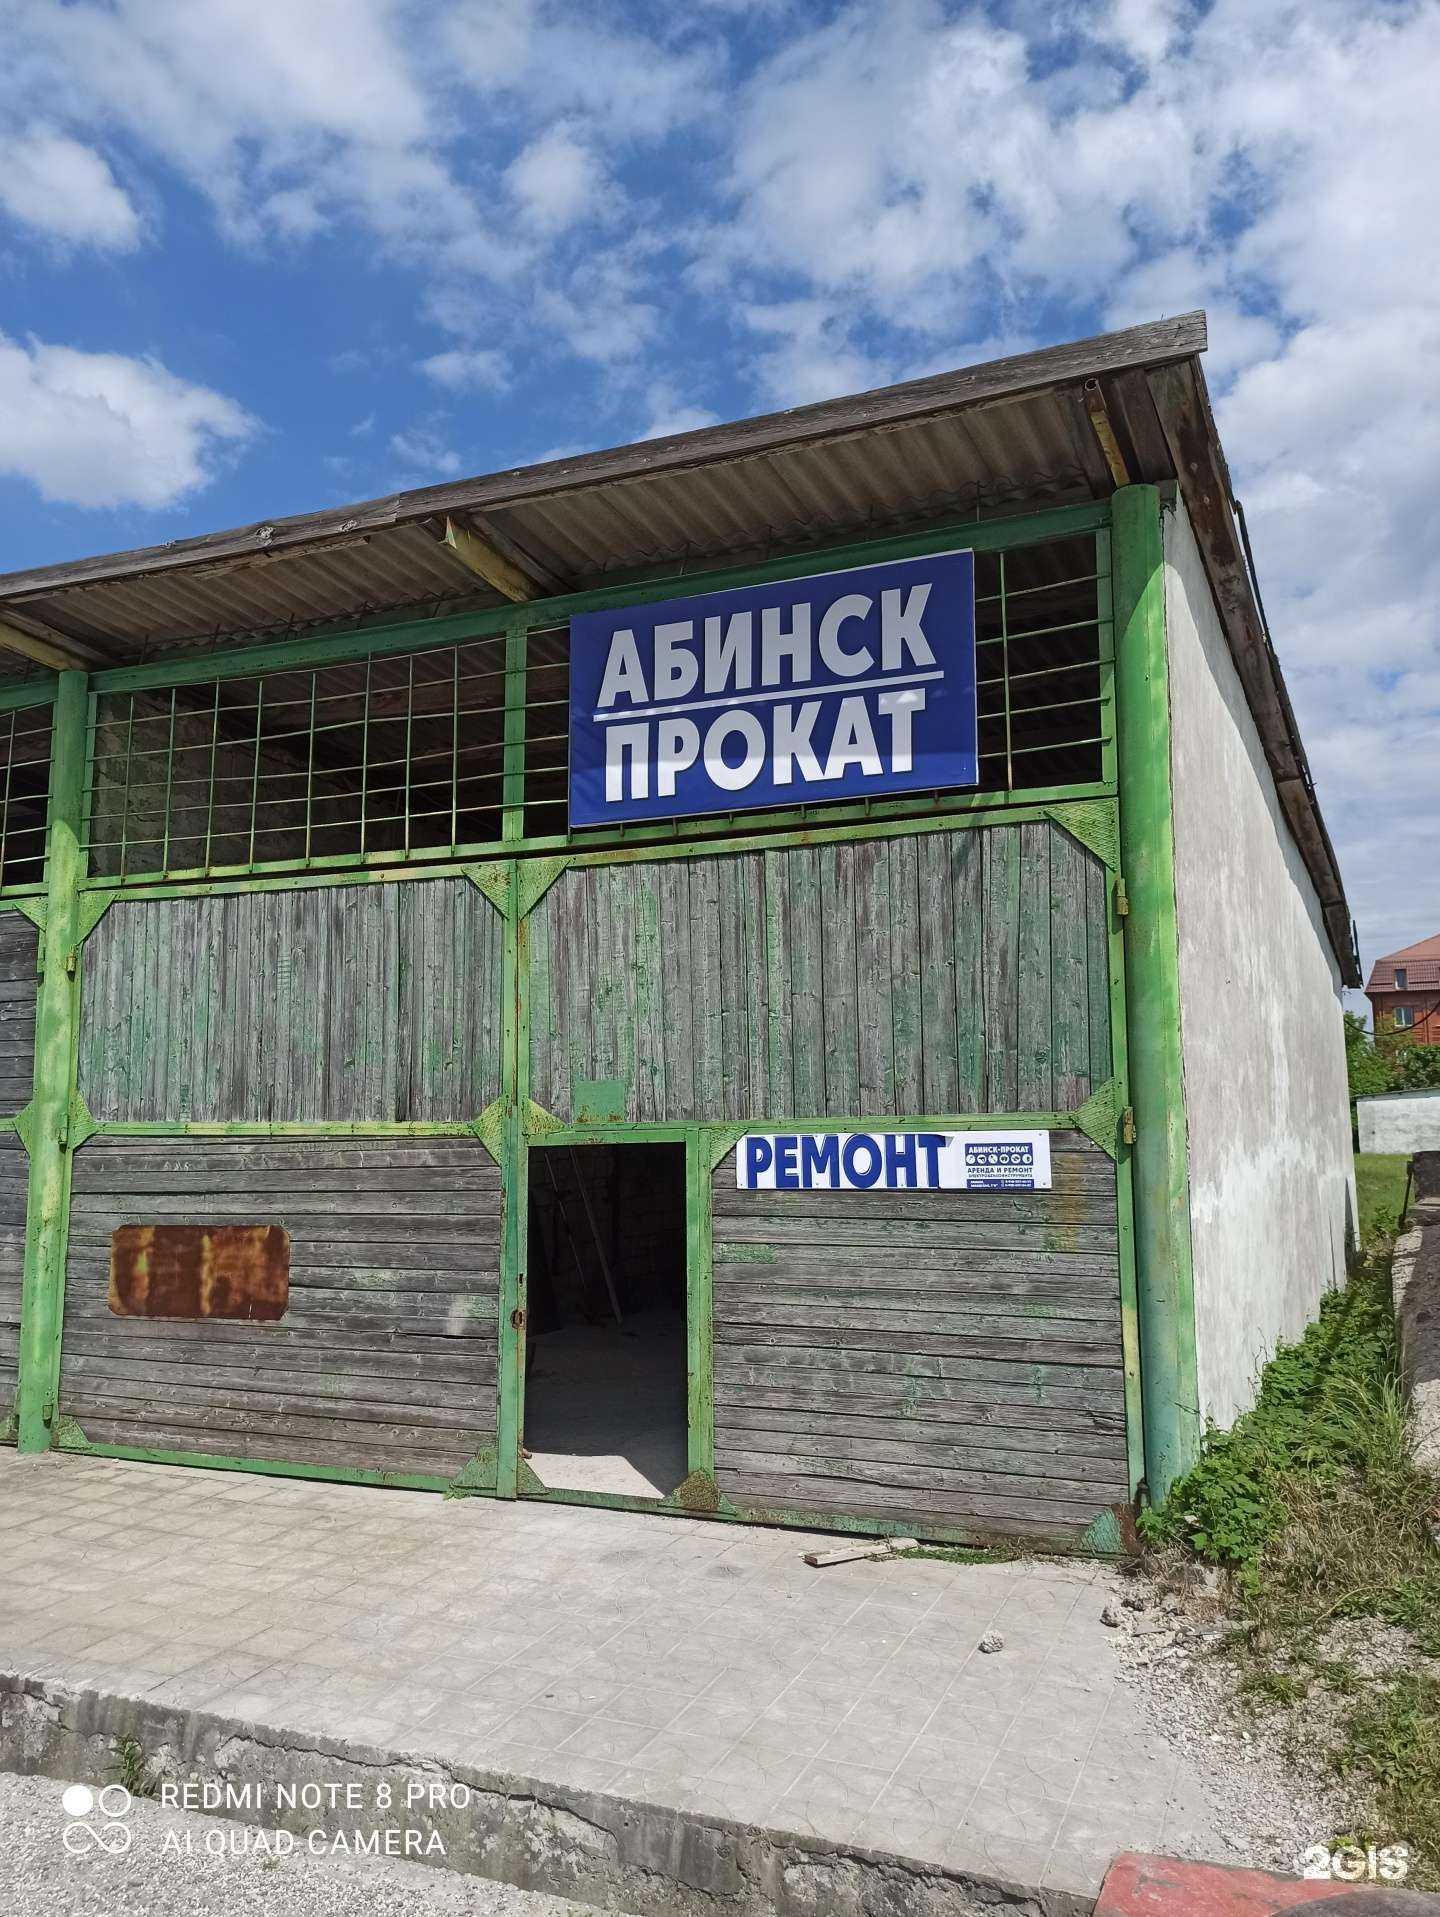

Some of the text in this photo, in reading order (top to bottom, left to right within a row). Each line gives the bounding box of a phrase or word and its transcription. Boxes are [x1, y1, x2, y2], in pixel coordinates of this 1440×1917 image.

[597, 583, 937, 708] АБИНСК
[605, 688, 926, 802] ПРОКАТ
[745, 1133, 948, 1189] РЕМОНТ
